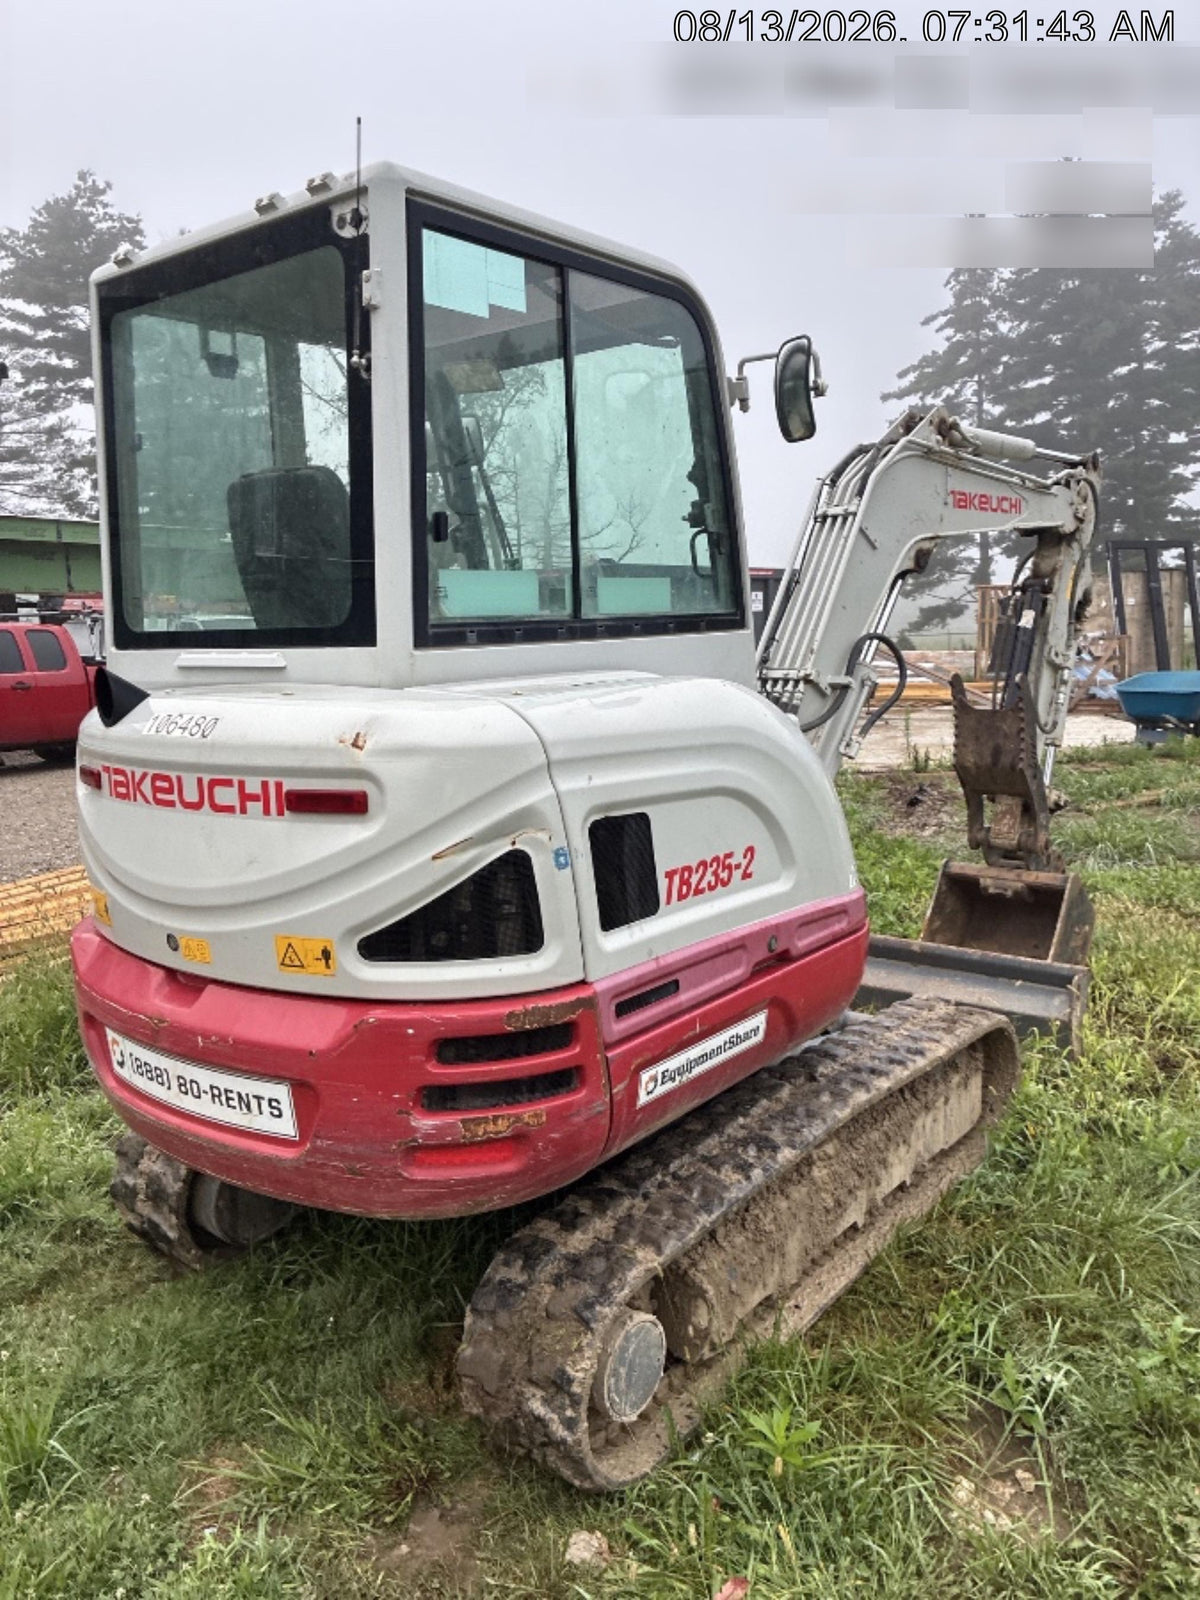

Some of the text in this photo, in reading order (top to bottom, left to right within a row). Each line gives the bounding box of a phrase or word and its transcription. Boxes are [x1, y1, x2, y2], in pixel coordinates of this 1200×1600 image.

[949, 490, 1022, 514] TAKEUCHI
[147, 713, 220, 739] 106480
[101, 764, 285, 817] TAKEUCHI
[664, 845, 756, 906] TB235-2
[660, 1024, 760, 1086] EquipmentShare
[129, 1051, 283, 1119] (888) 80-RENTS
